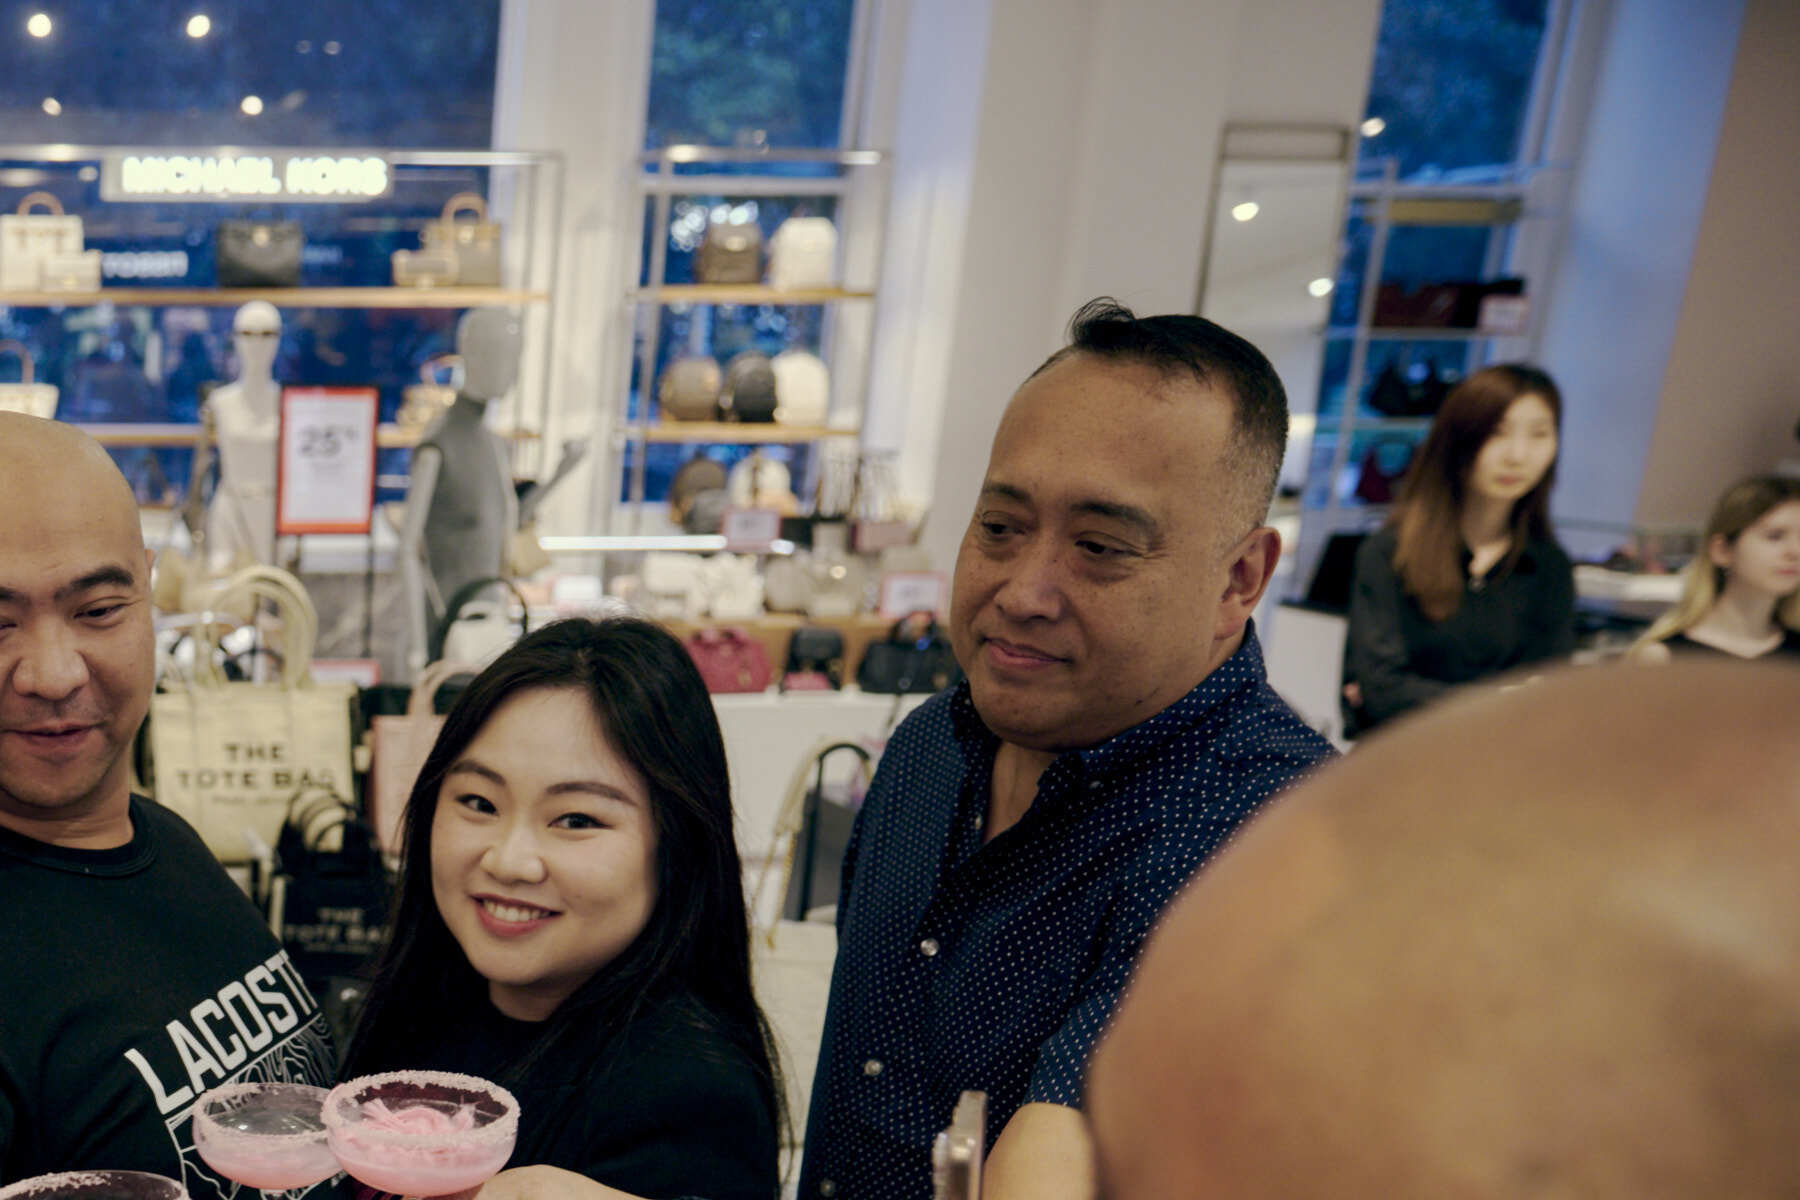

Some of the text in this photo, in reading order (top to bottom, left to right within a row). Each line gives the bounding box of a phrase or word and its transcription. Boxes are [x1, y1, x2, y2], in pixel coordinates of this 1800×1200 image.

[122, 156, 388, 196] MICHAEL KORS
[225, 744, 282, 761] THE
[176, 770, 258, 789] TOTE
